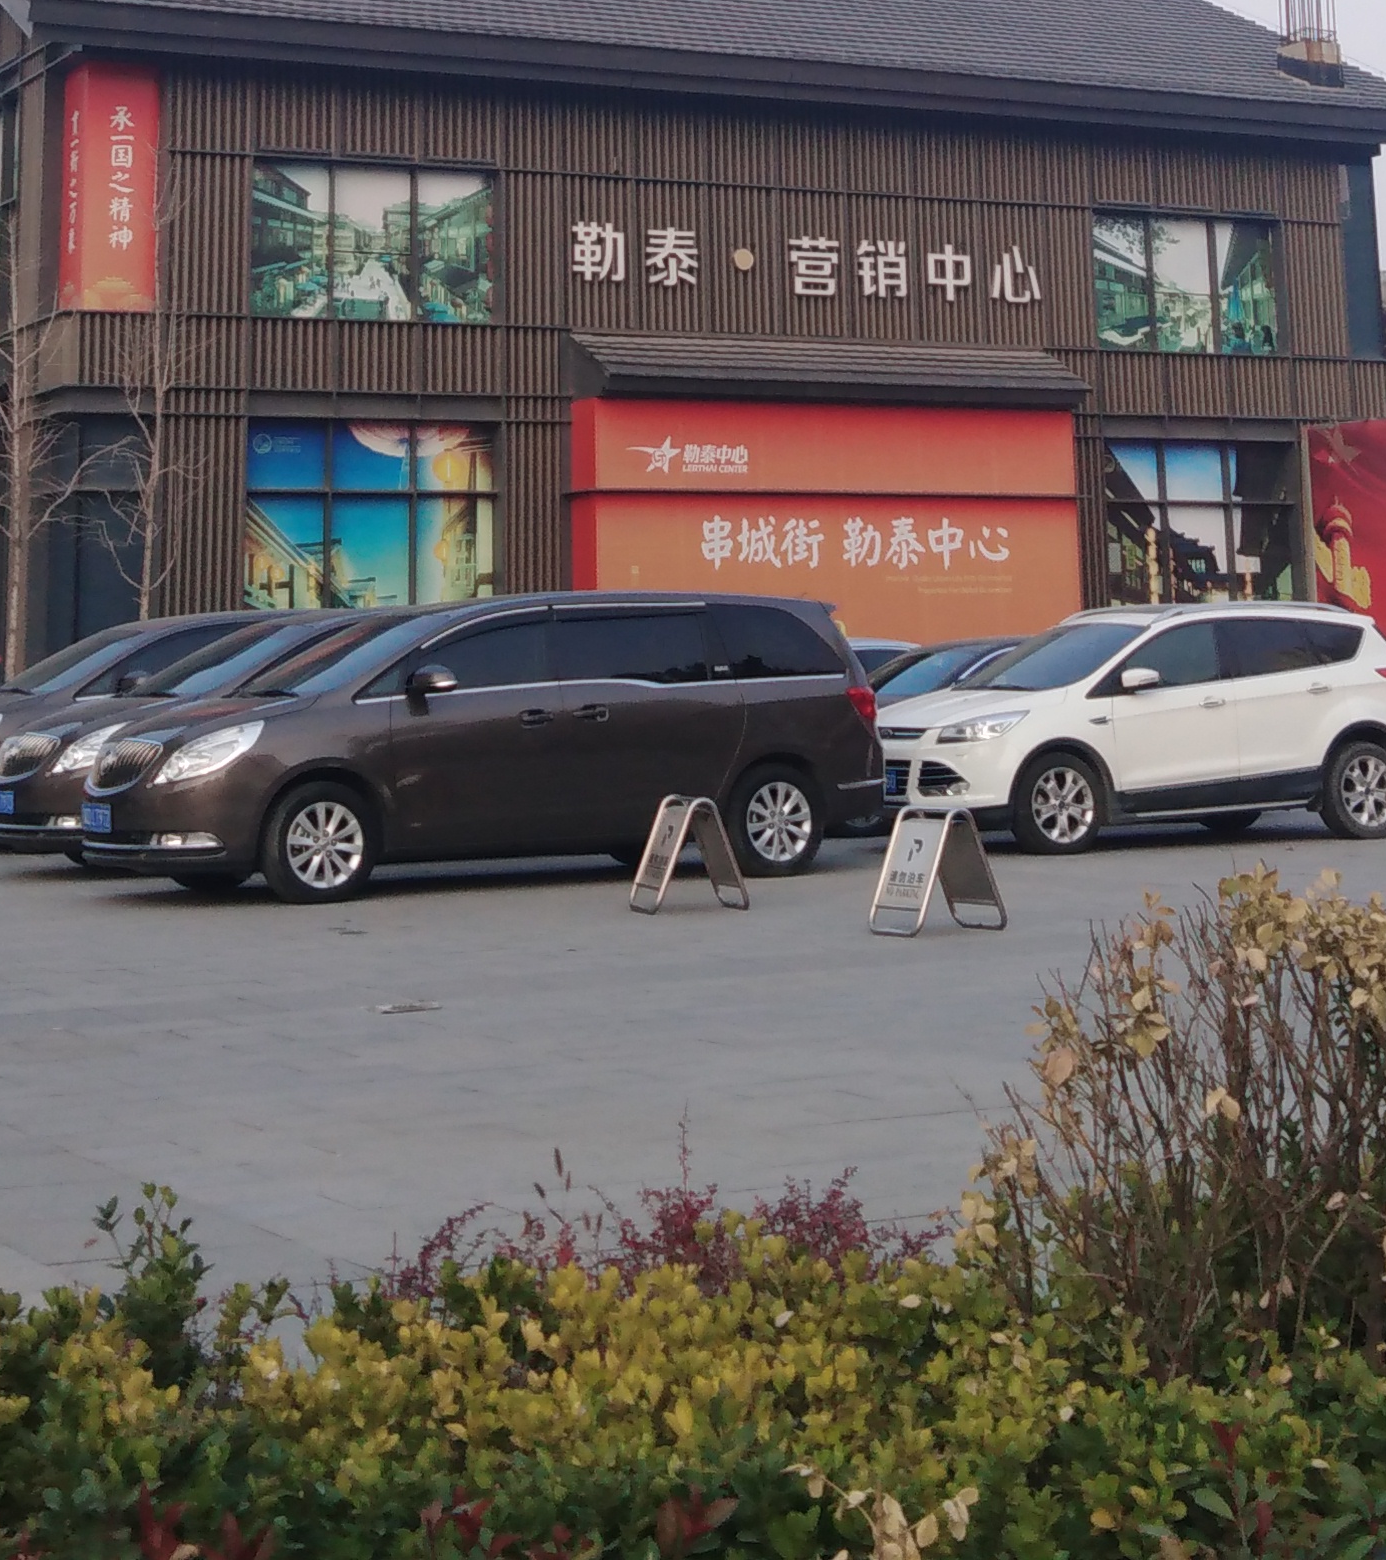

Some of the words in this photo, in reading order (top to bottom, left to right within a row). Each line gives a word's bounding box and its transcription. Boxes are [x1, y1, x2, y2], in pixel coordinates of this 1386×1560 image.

[109, 106, 135, 250] 承一国之精神
[682, 444, 749, 464] 勒泰中心
[718, 465, 749, 473] CENTER
[701, 515, 825, 570] 串城街
[842, 516, 1011, 570] 勒泰中心
[889, 869, 926, 885] 请勿泊车
